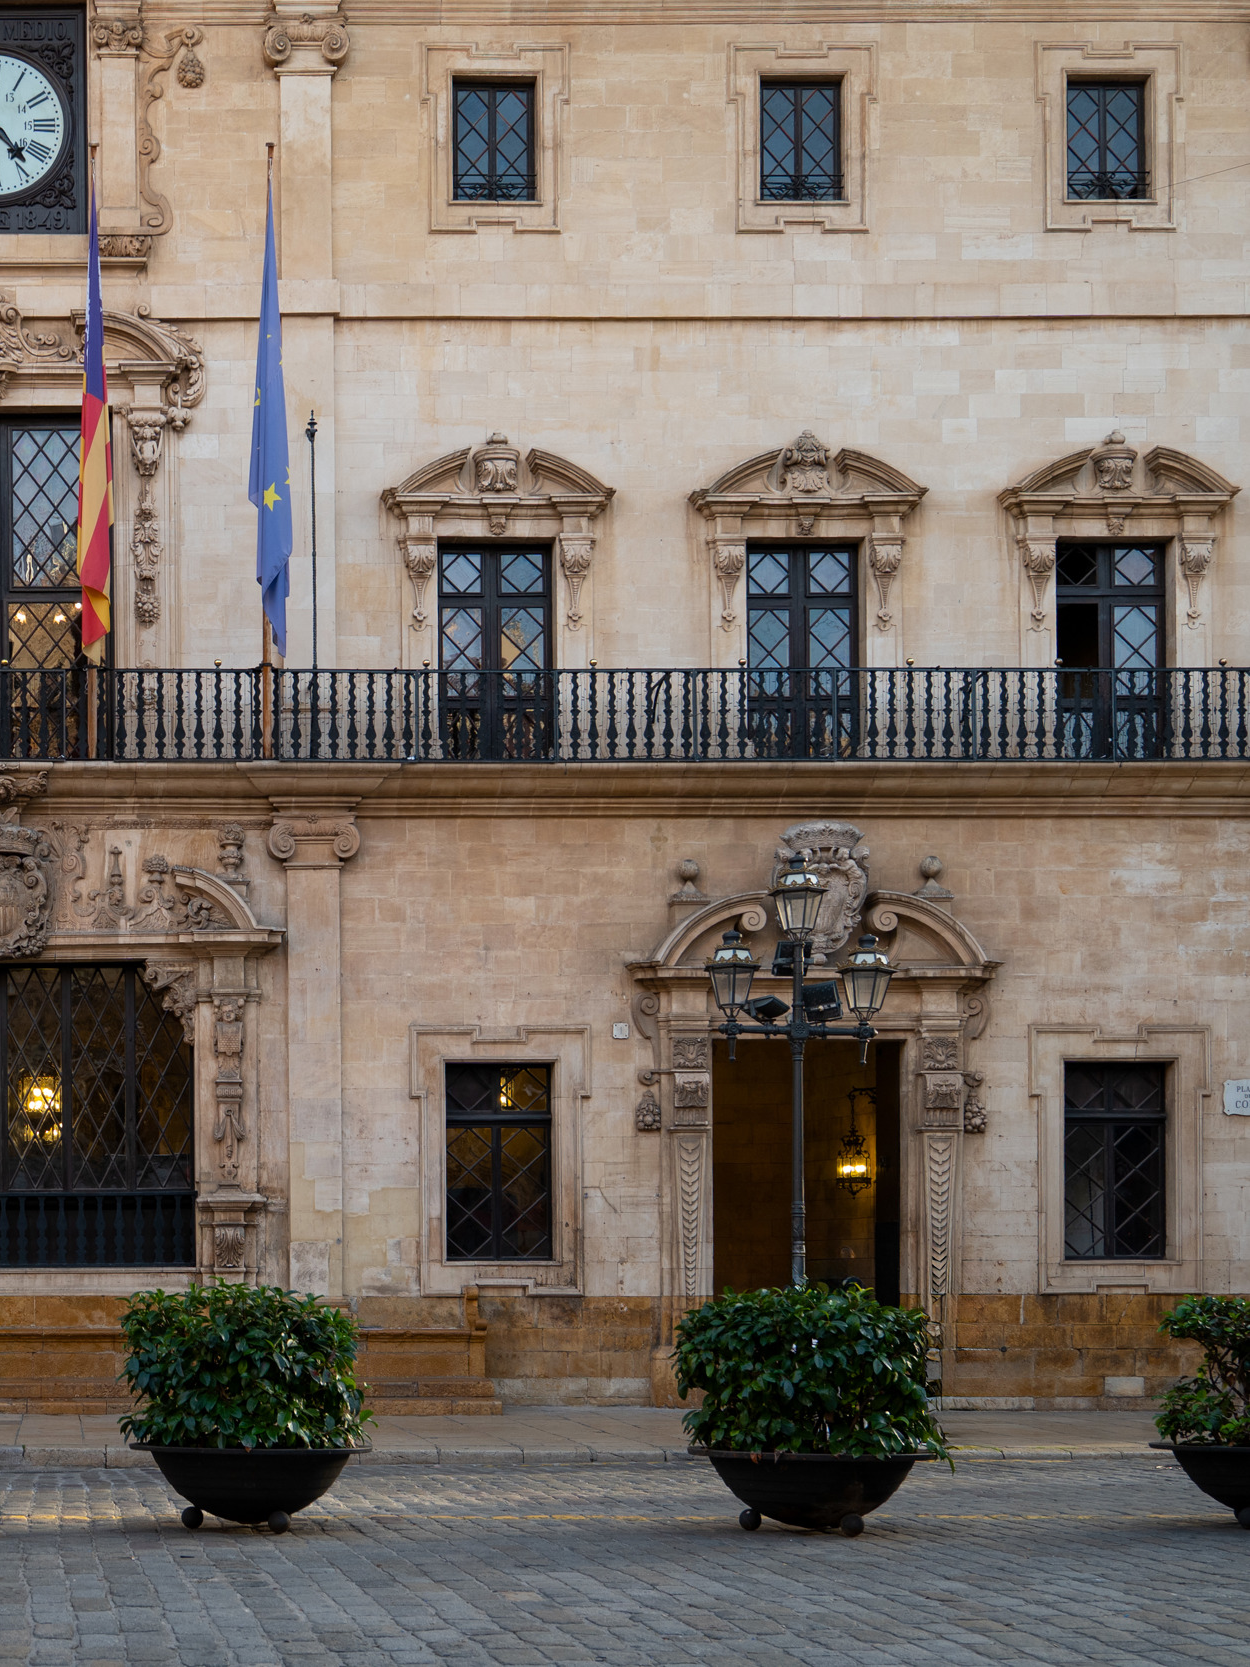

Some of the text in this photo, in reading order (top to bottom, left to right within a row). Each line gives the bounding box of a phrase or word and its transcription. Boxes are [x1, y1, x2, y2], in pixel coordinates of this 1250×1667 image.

[3, 21, 71, 41] MEDIO.
[5, 92, 15, 103] 13
[18, 104, 27, 114] 14
[24, 121, 33, 131] 15
[19, 137, 28, 148] 16
